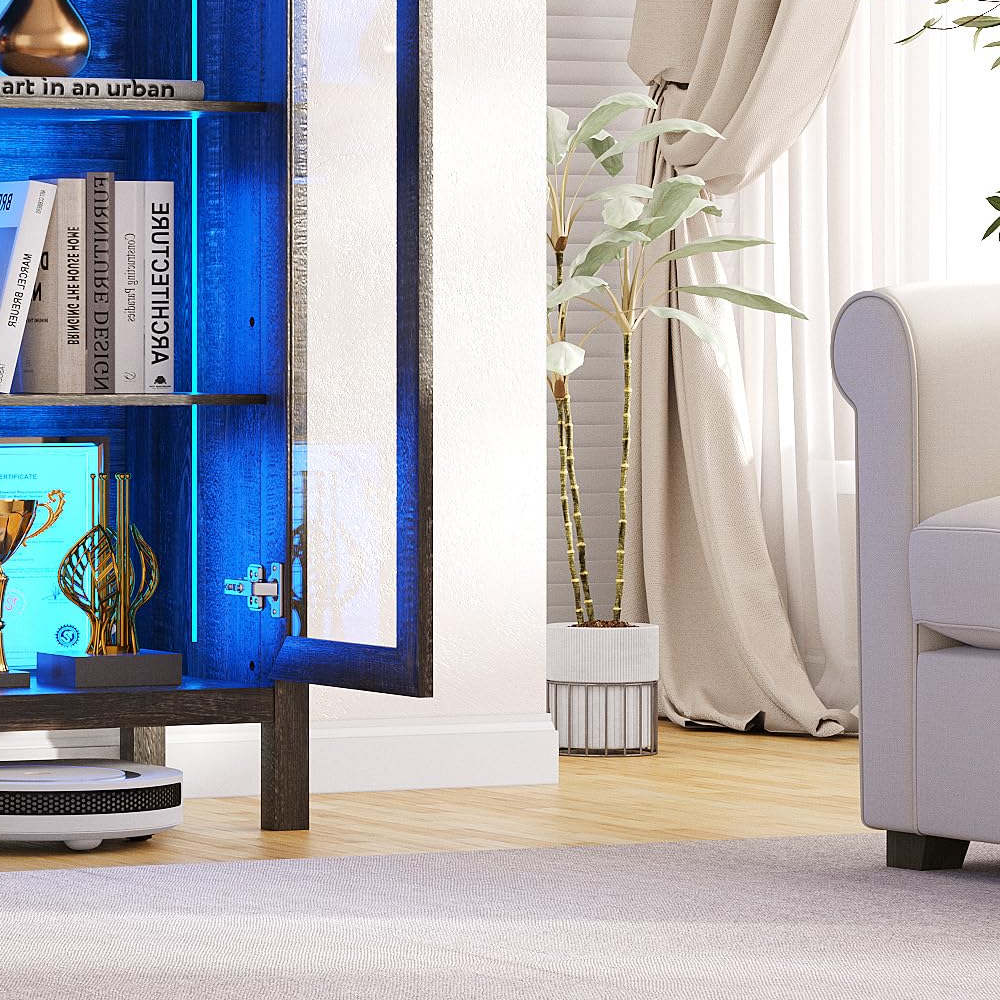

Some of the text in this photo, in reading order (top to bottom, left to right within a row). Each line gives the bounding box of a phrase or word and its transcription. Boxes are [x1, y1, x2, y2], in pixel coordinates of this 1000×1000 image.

[2, 77, 175, 98] art in an urban
